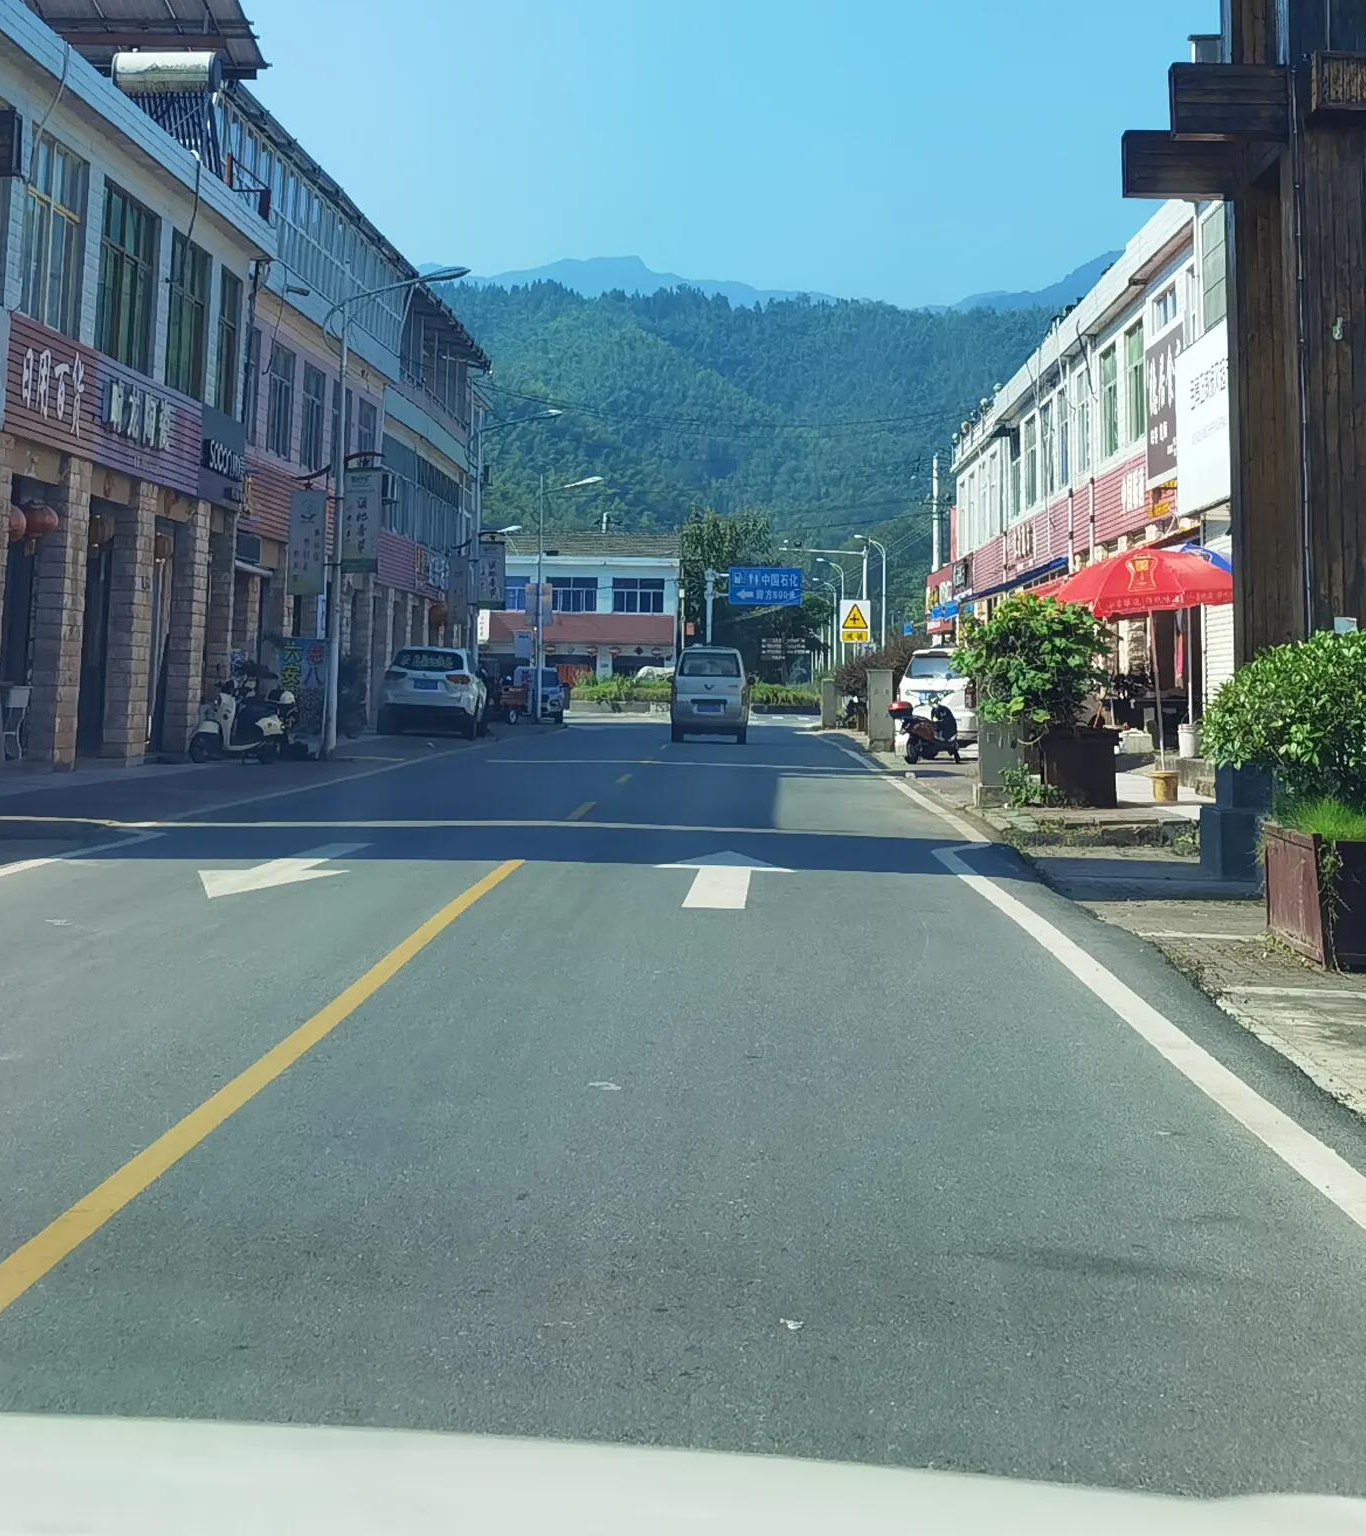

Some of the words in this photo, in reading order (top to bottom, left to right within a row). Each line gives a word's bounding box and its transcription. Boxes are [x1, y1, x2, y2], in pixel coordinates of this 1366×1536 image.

[22, 347, 85, 441] 日用百货
[761, 573, 799, 587] 中国石化
